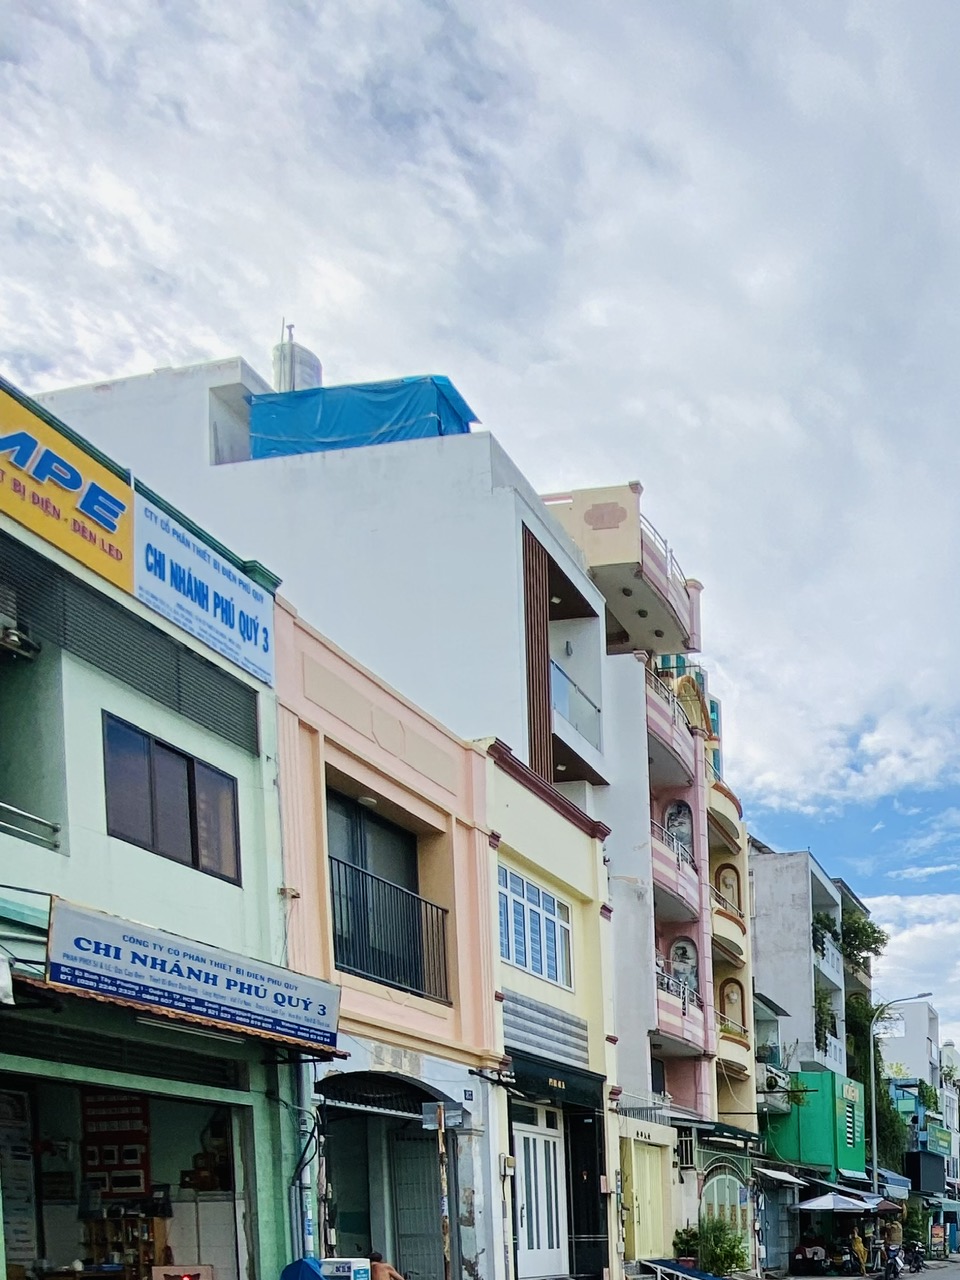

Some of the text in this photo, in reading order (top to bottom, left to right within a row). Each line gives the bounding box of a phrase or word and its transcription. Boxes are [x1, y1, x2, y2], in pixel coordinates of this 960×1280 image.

[100, 537, 123, 561] LED
[145, 543, 165, 582] CHI
[170, 566, 209, 612] NHÁNH
[213, 590, 235, 630] PHÚ
[239, 610, 260, 646] QUÝ
[262, 626, 269, 653] 3
[73, 934, 121, 960] CHI
[130, 947, 220, 987] NHÁNH
[225, 974, 267, 999] PHÚ
[273, 988, 313, 1013] QUÝ
[317, 1003, 326, 1016] 3
